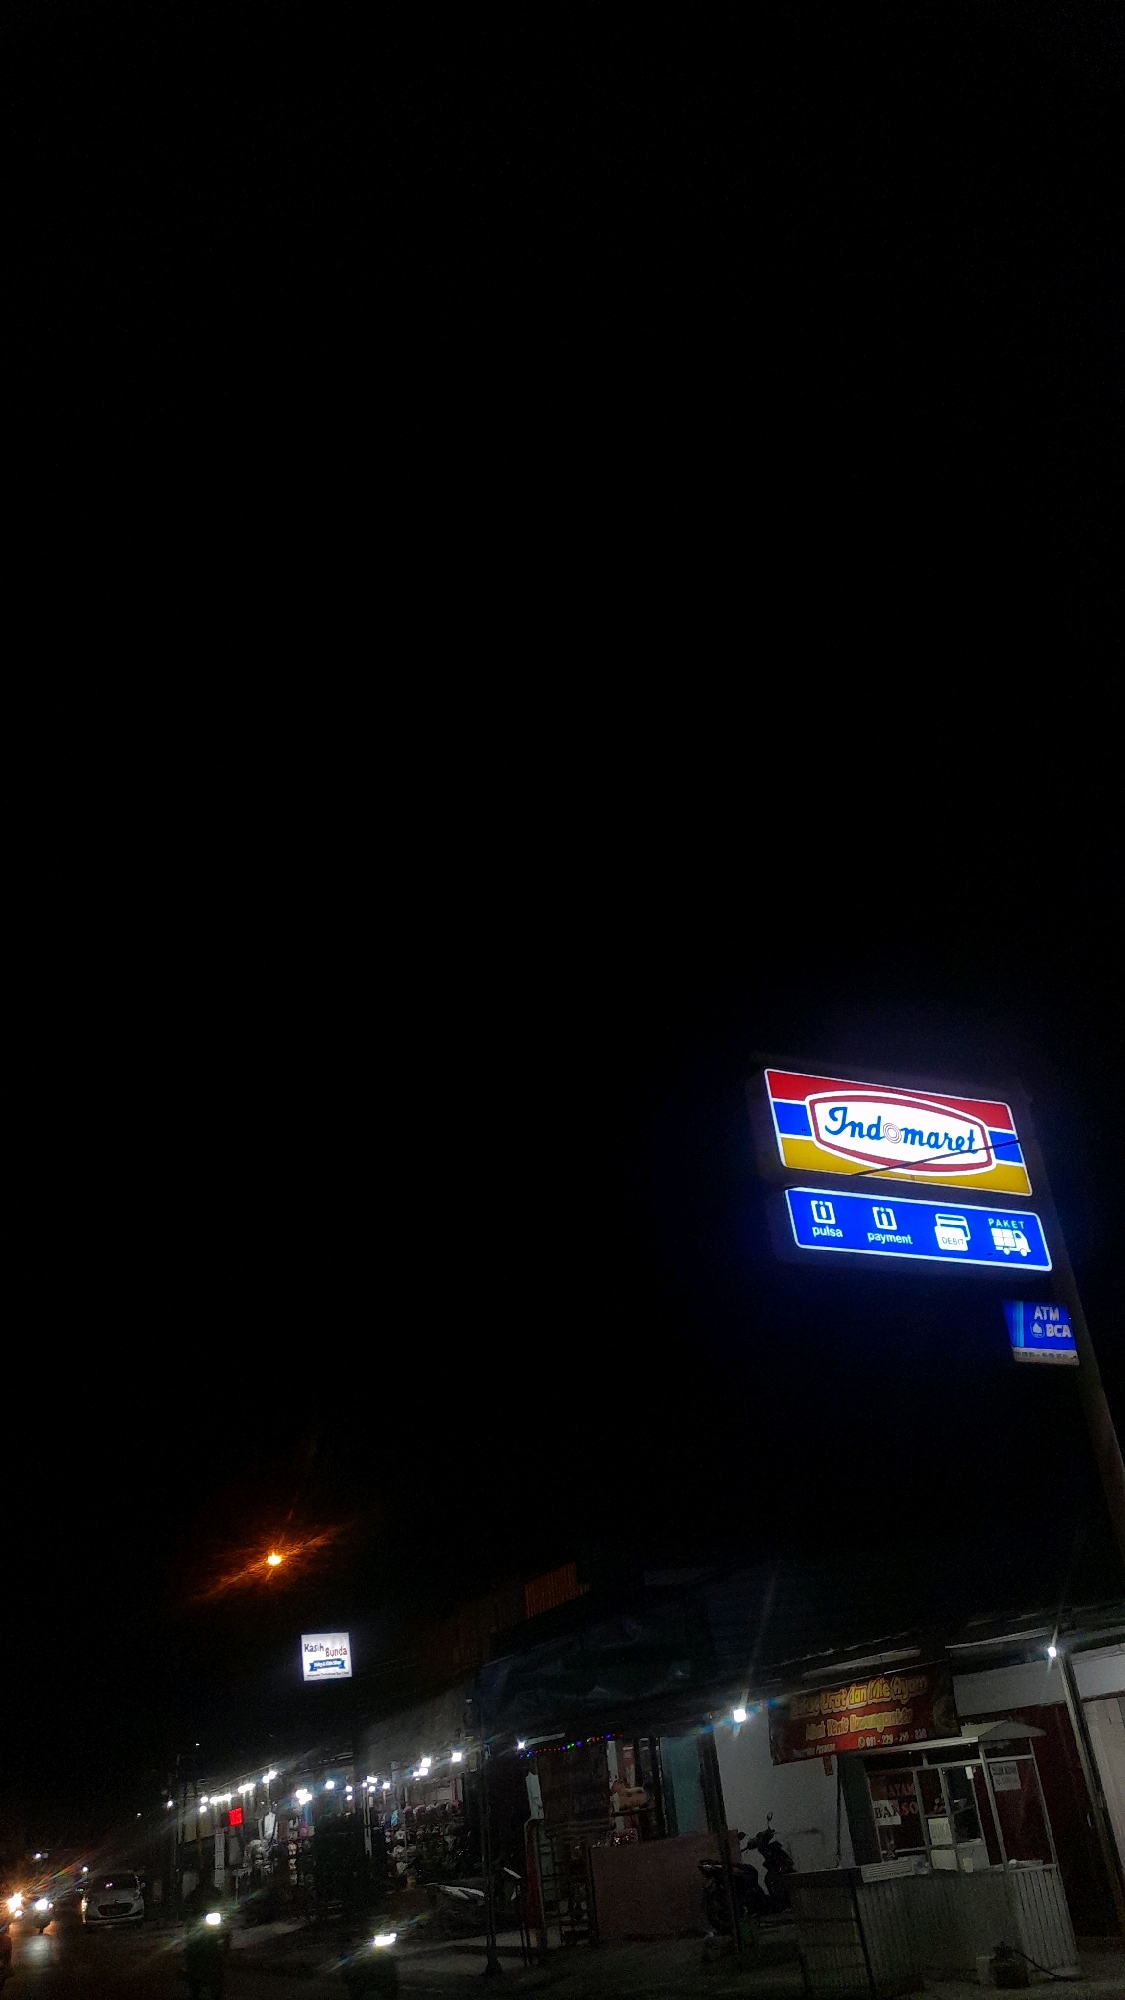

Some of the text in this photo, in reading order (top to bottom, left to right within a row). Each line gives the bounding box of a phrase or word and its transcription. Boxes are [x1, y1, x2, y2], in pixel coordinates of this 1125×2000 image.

[825, 1106, 979, 1154] Indomaret
[987, 1217, 1025, 1229] PAKET
[811, 1225, 844, 1238] pulsa
[867, 1231, 914, 1245] payment
[941, 1236, 965, 1246] DEBIT
[1033, 1305, 1060, 1321] ATM
[1045, 1323, 1072, 1338] BCA
[325, 1646, 348, 1658] Bunda
[848, 1684, 867, 1708] dan
[868, 1678, 891, 1703] Mie
